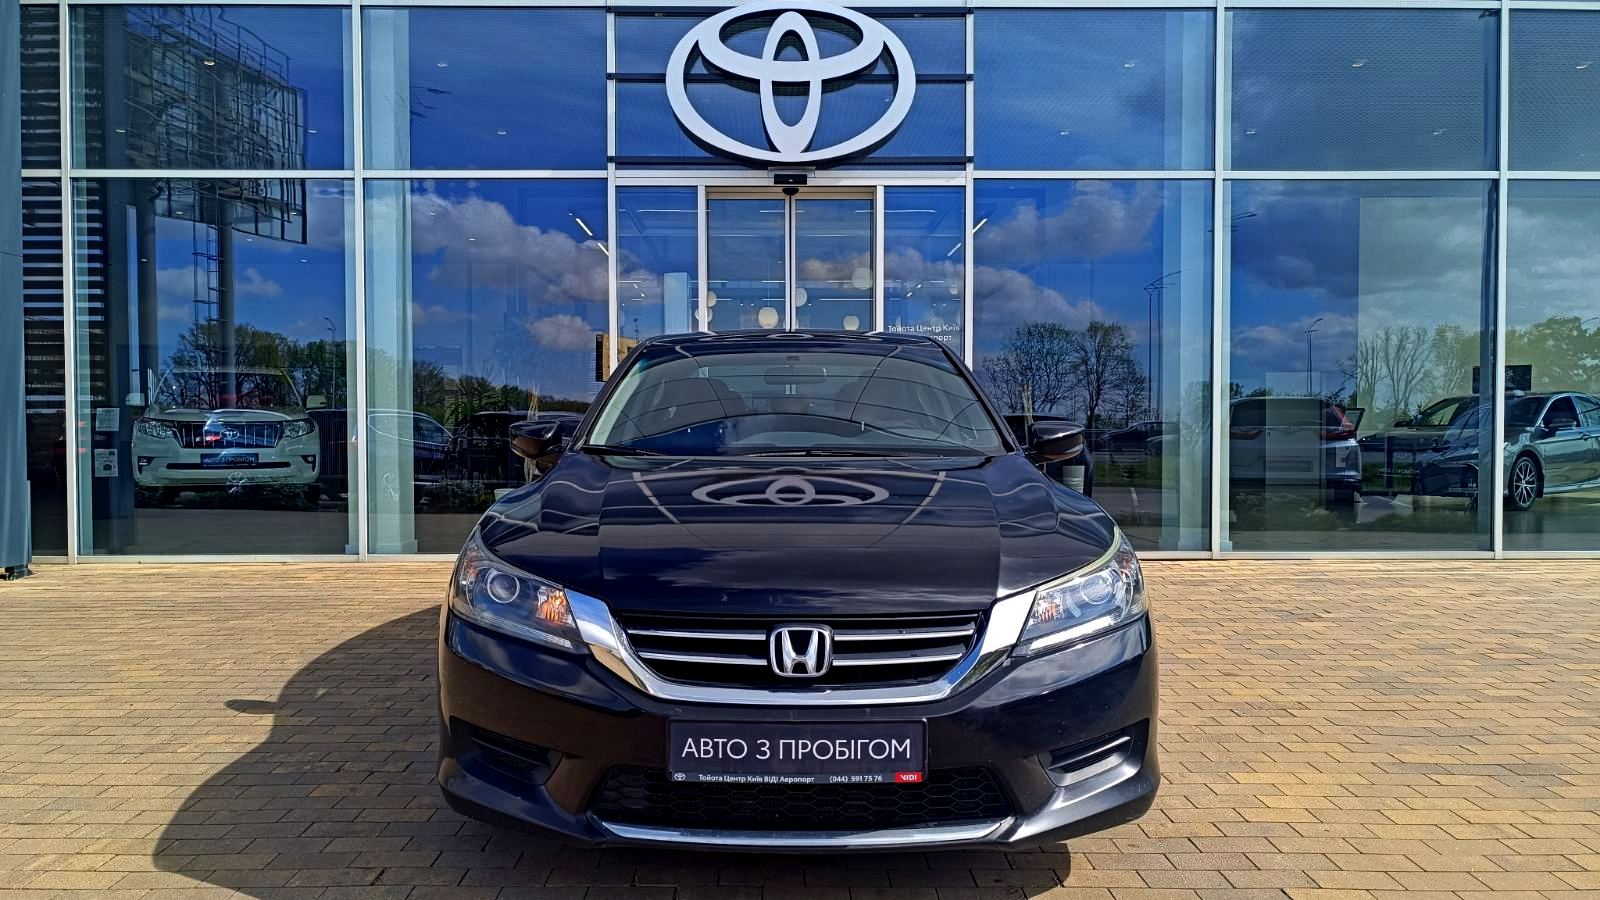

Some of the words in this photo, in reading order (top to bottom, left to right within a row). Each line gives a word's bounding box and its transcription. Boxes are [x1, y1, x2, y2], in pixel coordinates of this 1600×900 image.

[888, 325, 915, 333] Тойота
[917, 325, 941, 333] Центр
[681, 738, 748, 759] АВТО
[756, 739, 770, 760] З
[779, 738, 911, 760] ПРОБІГОМ
[698, 774, 723, 782] Тойота
[724, 775, 746, 783] Центр
[748, 775, 763, 783] Київ
[780, 776, 815, 784] Аеропорт
[829, 775, 848, 783] (044)
